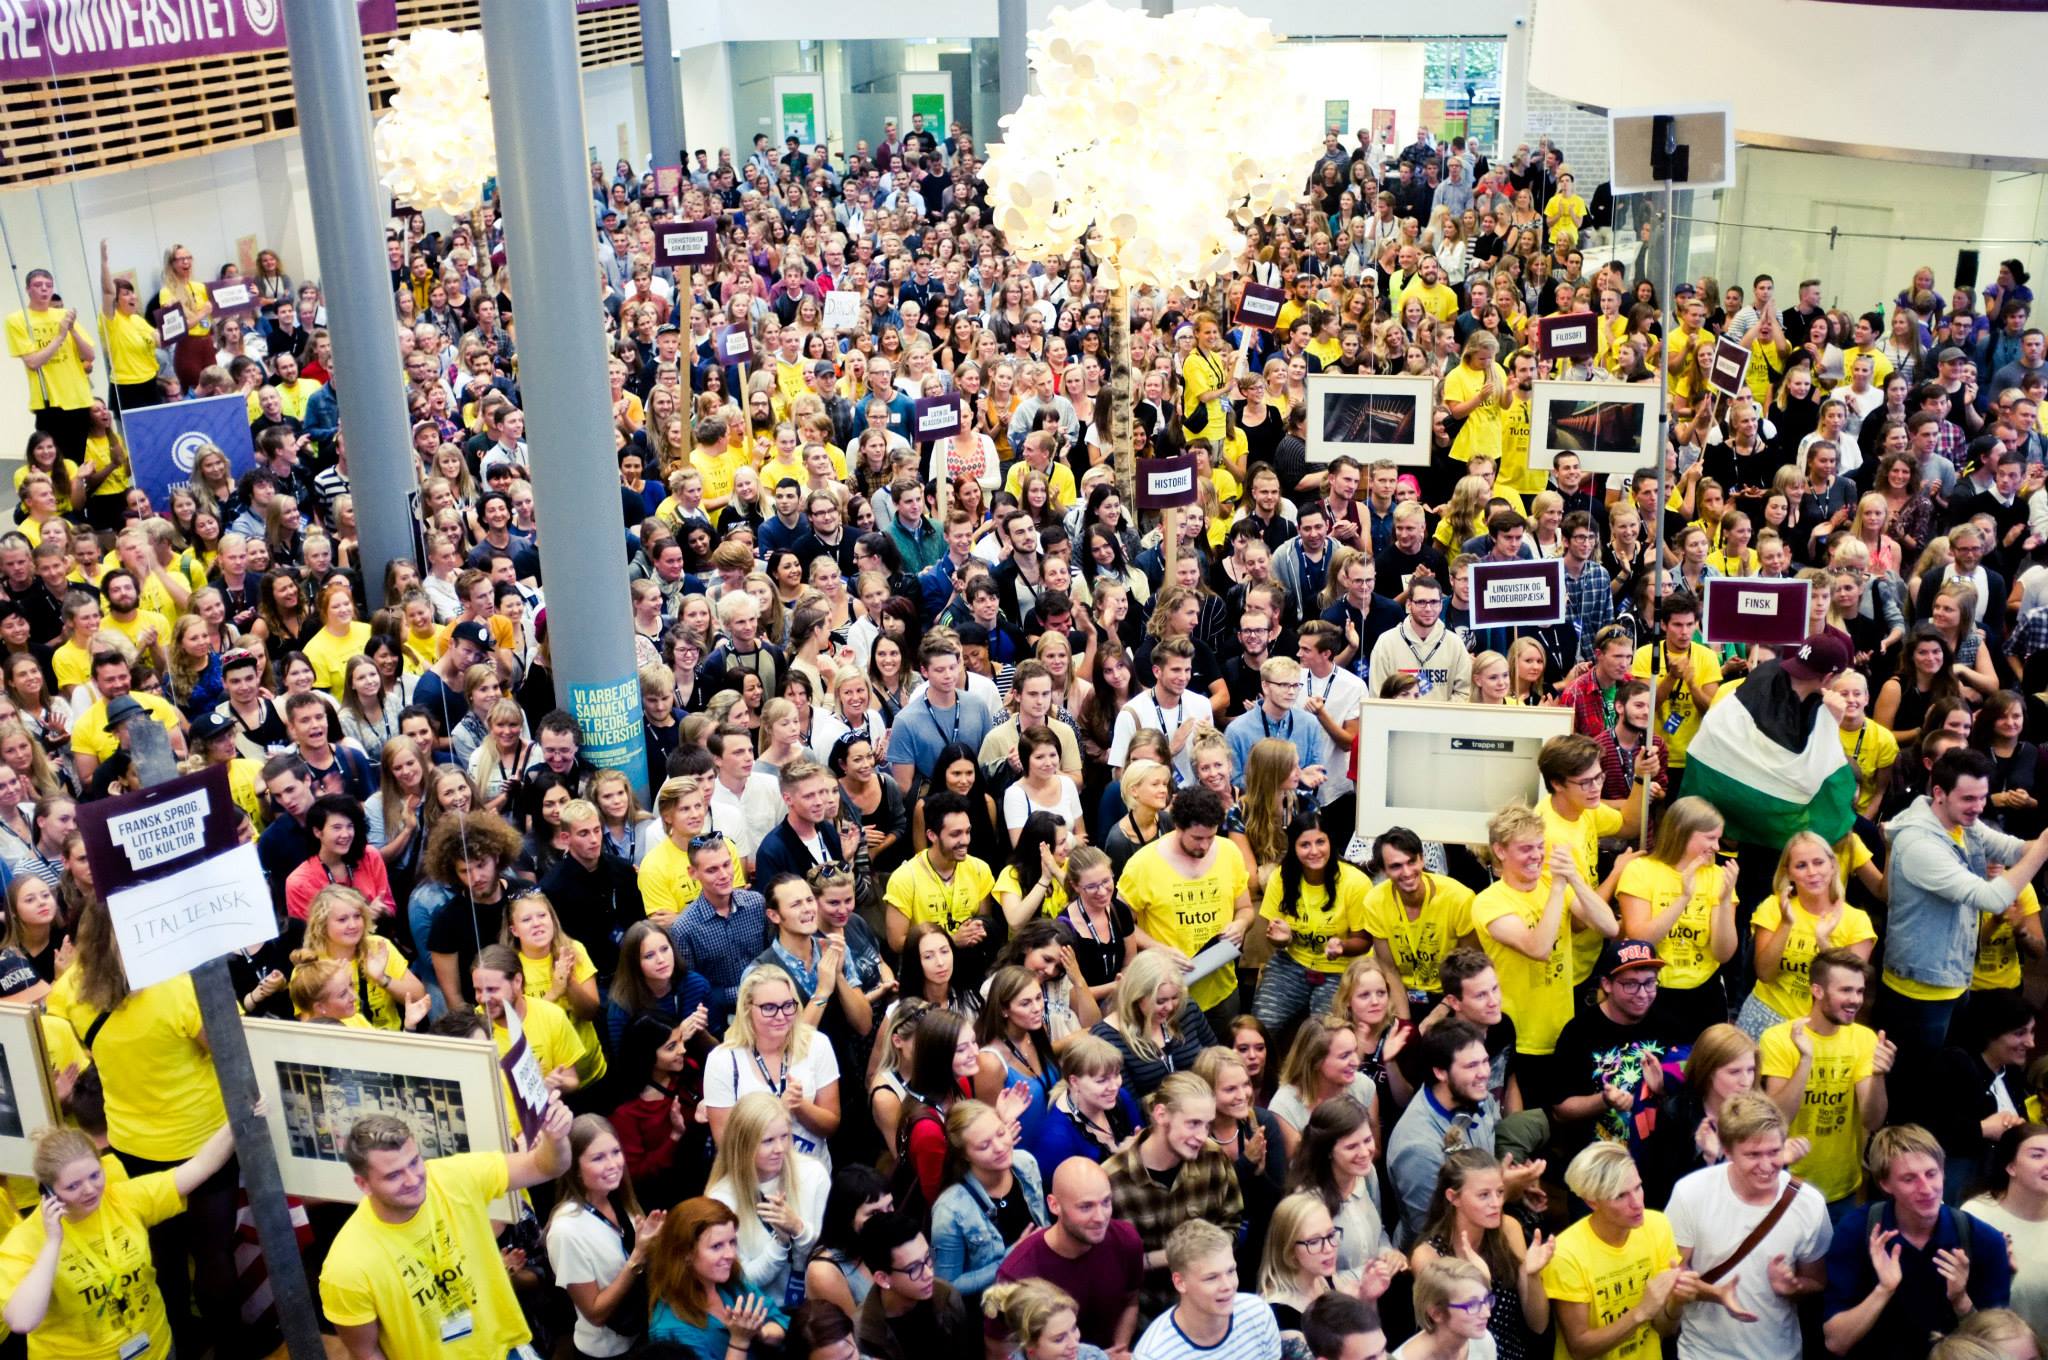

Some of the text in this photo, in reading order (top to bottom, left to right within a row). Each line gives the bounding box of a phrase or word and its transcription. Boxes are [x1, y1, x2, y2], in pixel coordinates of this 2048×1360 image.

[1555, 331, 1582, 341] FILOSOFI
[1509, 428, 1530, 436] Tuto
[1154, 475, 1187, 489] HISTORIE
[1492, 582, 1541, 594] LINGVISTIK OG
[1489, 592, 1545, 604] INDOEUROPÆISK
[1745, 598, 1771, 609] FINSK
[574, 679, 637, 705] VI ARBEJDER
[576, 699, 625, 719] SAMMEN
[594, 711, 629, 732] BEDRE
[1472, 741, 1496, 749] trappe
[118, 813, 162, 836] FRANSK
[132, 817, 195, 848] LITTERATUR
[138, 832, 196, 861] OG KULTUR
[132, 890, 252, 944] ITALIENSK
[1175, 911, 1217, 926] Tutor
[1668, 926, 1701, 941] utor
[1780, 957, 1808, 974] Tut
[1804, 1090, 1846, 1106] Tutor
[78, 1267, 141, 1305] Tuor
